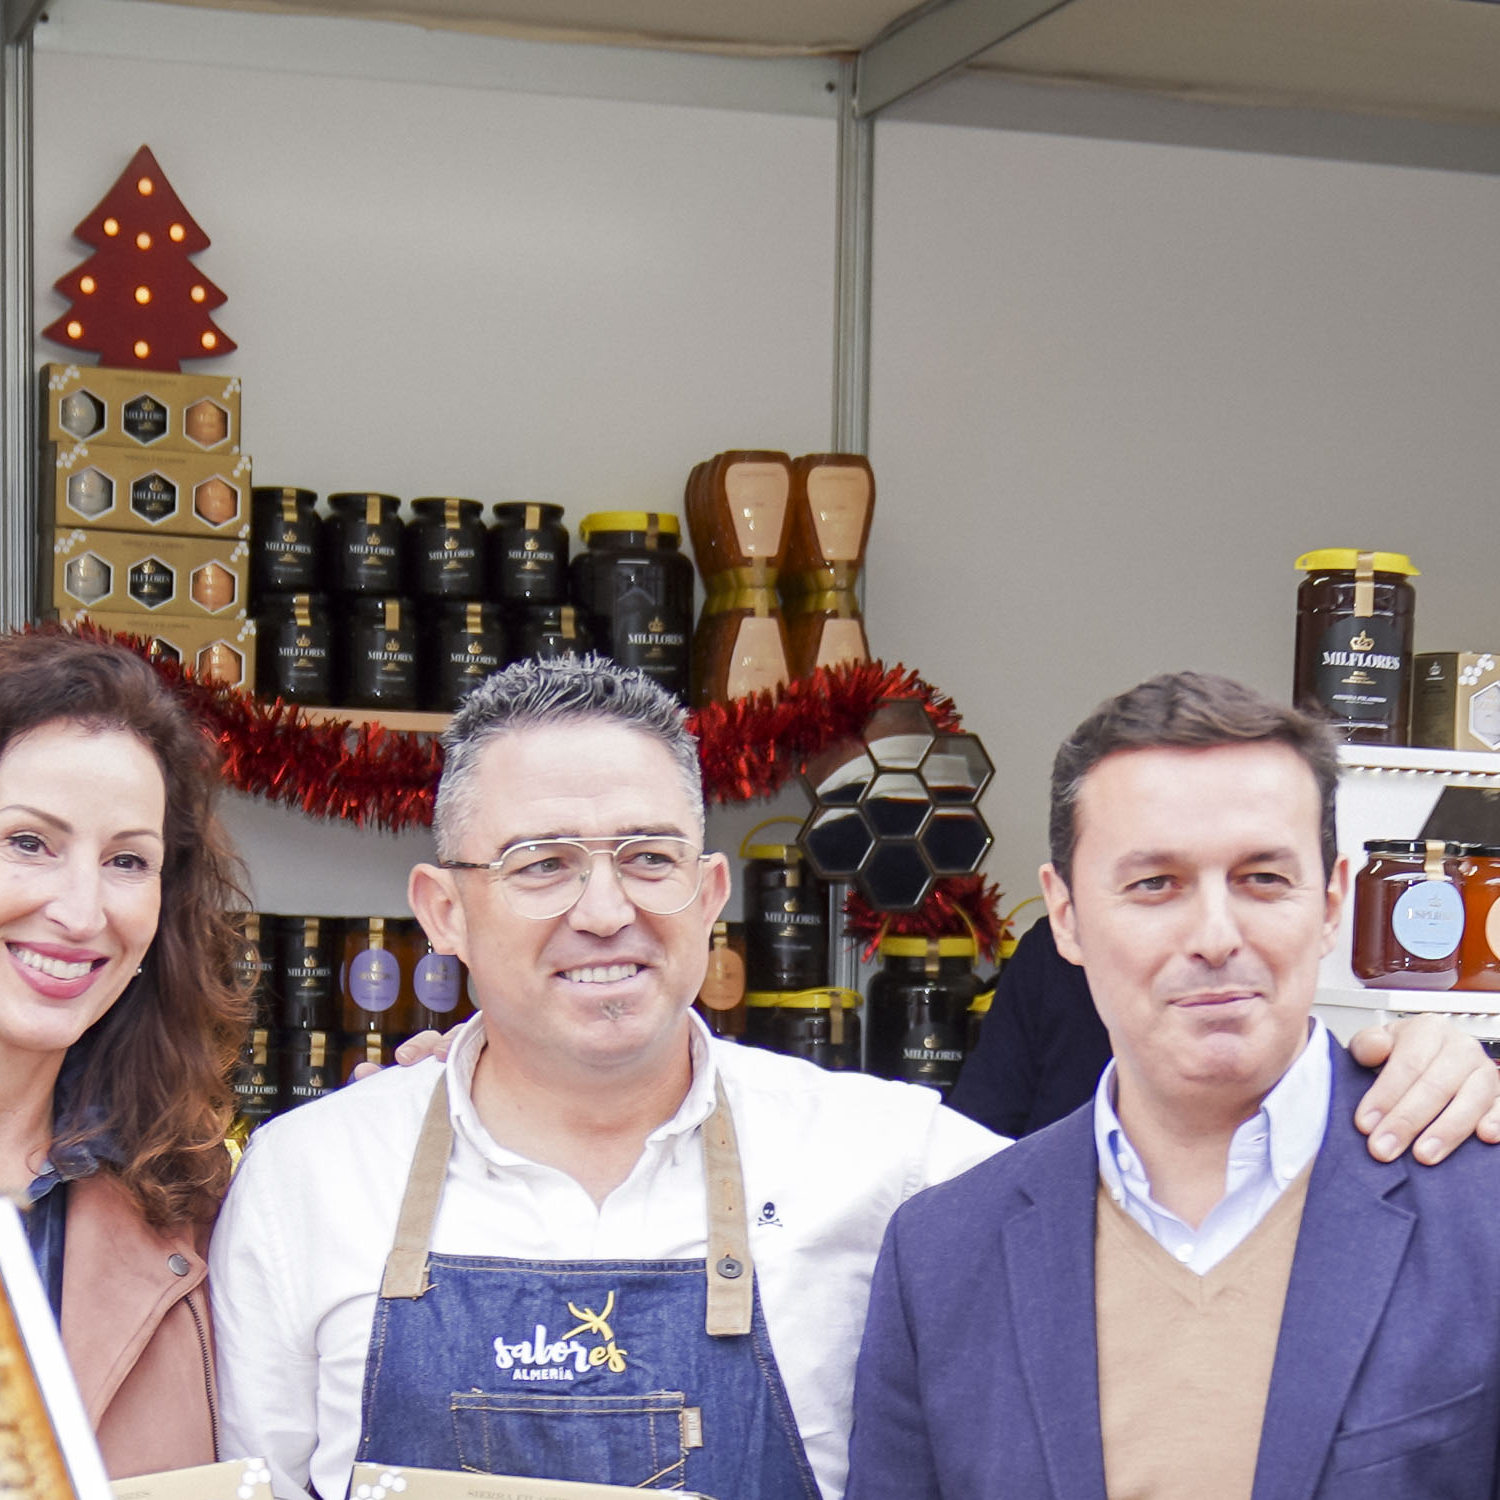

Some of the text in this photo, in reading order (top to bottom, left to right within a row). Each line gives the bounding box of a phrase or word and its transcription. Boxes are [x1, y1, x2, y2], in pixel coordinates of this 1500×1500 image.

[264, 542, 312, 554] MILFLORES
[348, 544, 396, 557] MILFLORES
[428, 549, 475, 561] MILFLORES
[507, 550, 555, 562] MILFLORES
[627, 633, 683, 646] MILFLORES
[278, 647, 326, 658] MILFLORES
[367, 650, 413, 662] MILFLORES
[449, 652, 498, 666] MILFLORES
[1321, 650, 1400, 671] MILFLORES
[764, 911, 820, 925] MILFLORES
[287, 967, 331, 977] MILFLORES
[902, 1048, 963, 1061] MILFLORES
[234, 1085, 278, 1095] MILFLORES
[493, 1323, 628, 1373] sabores
[512, 1367, 575, 1381] ALMERÍA
